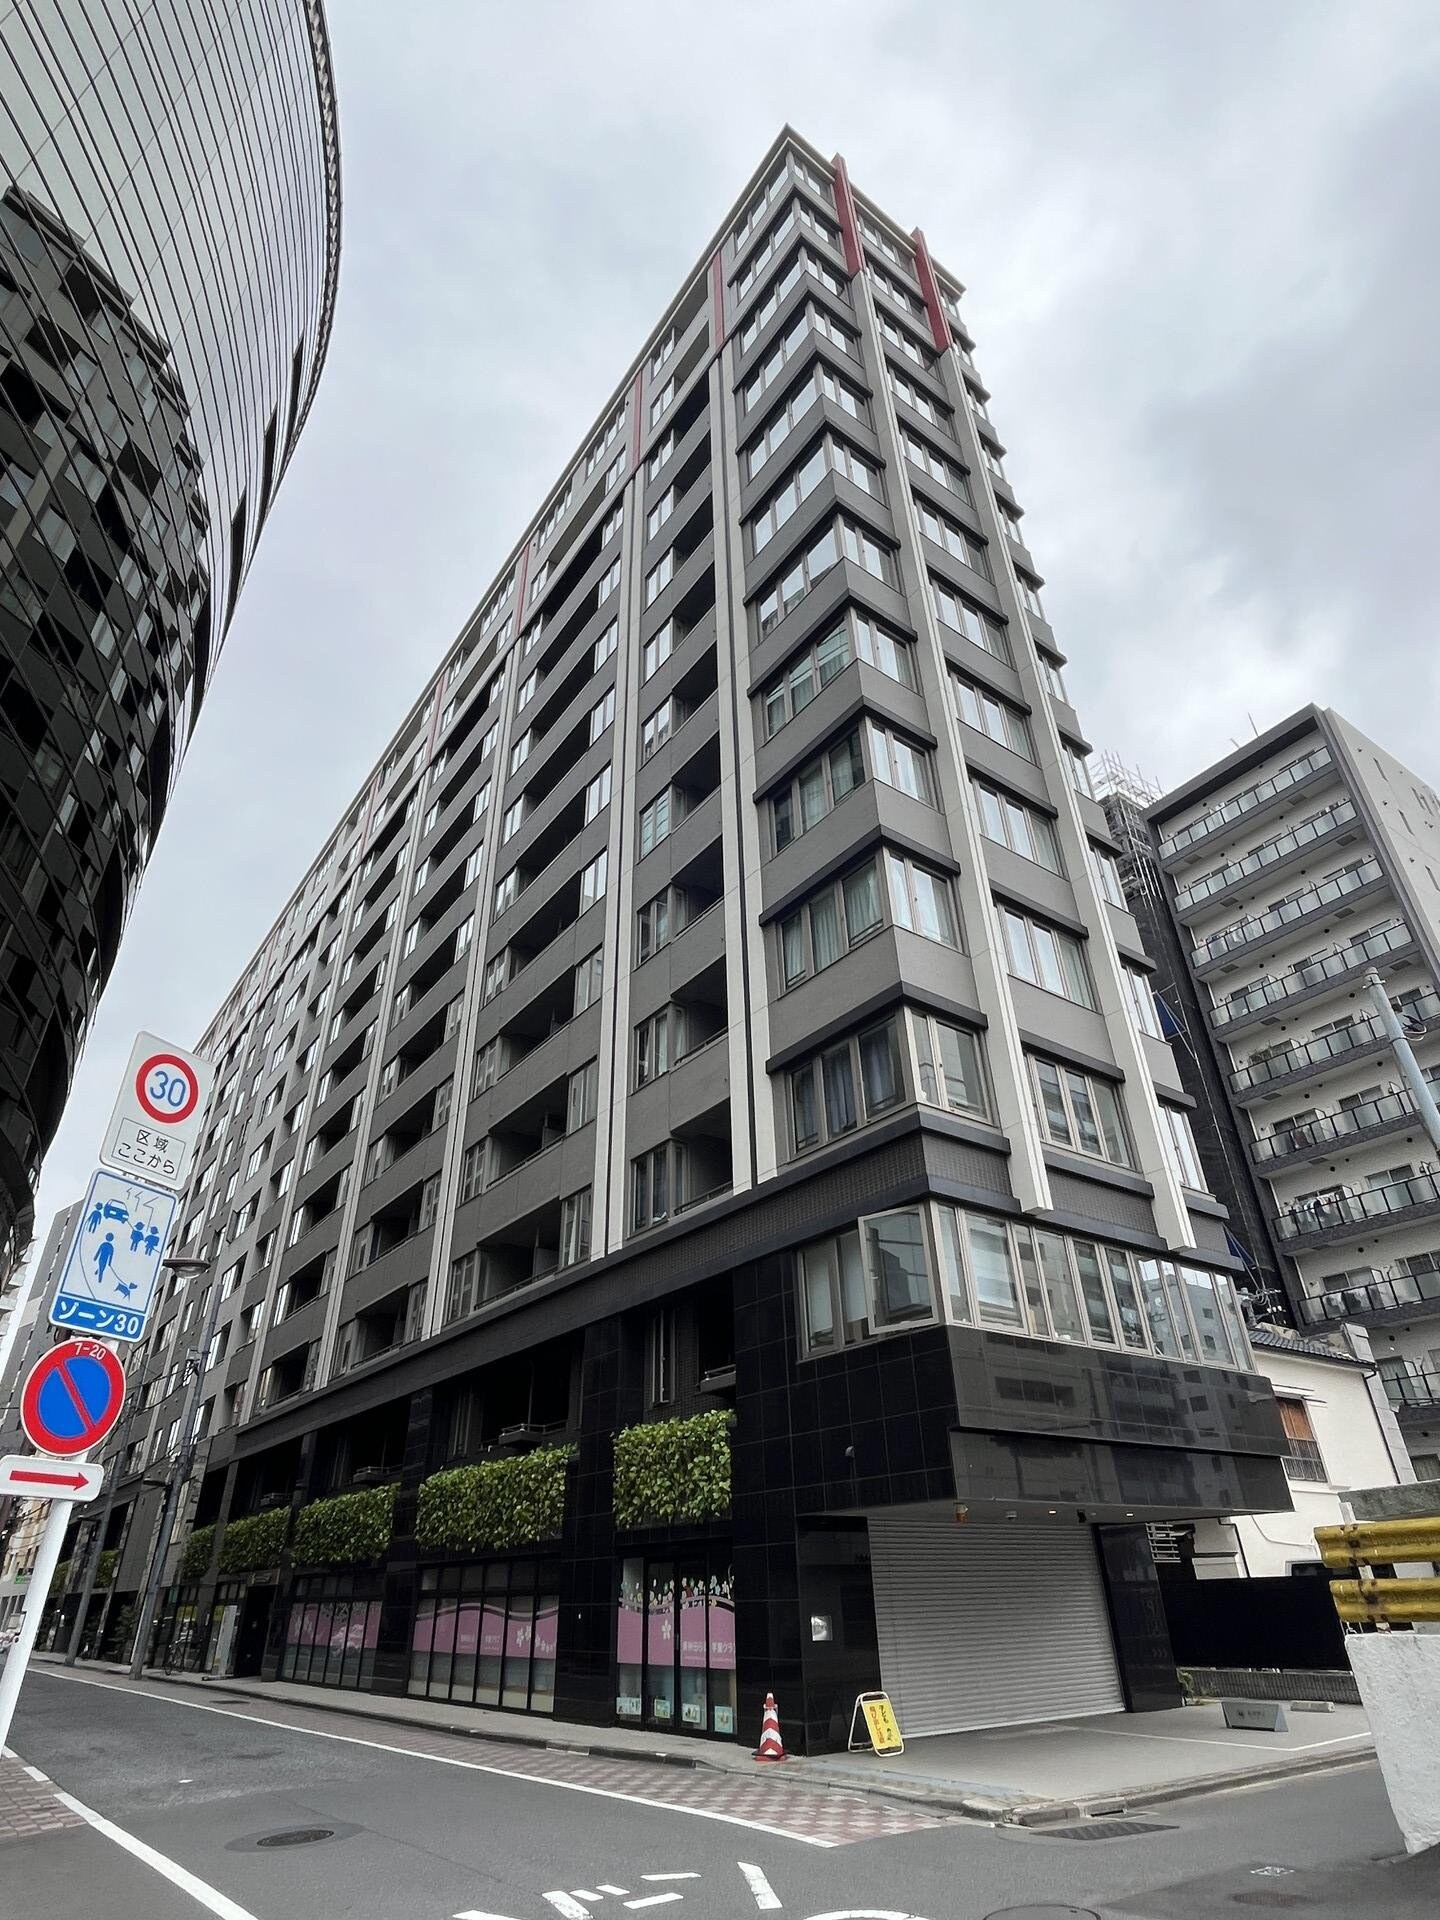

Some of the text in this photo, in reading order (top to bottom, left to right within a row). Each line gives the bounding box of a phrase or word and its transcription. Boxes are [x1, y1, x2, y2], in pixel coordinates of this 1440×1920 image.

[150, 1070, 186, 1107] 30
[136, 1129, 169, 1153] 区域
[118, 1142, 175, 1174] ここから
[58, 1301, 140, 1335] ゾーン30
[75, 1342, 107, 1360] 7-20
